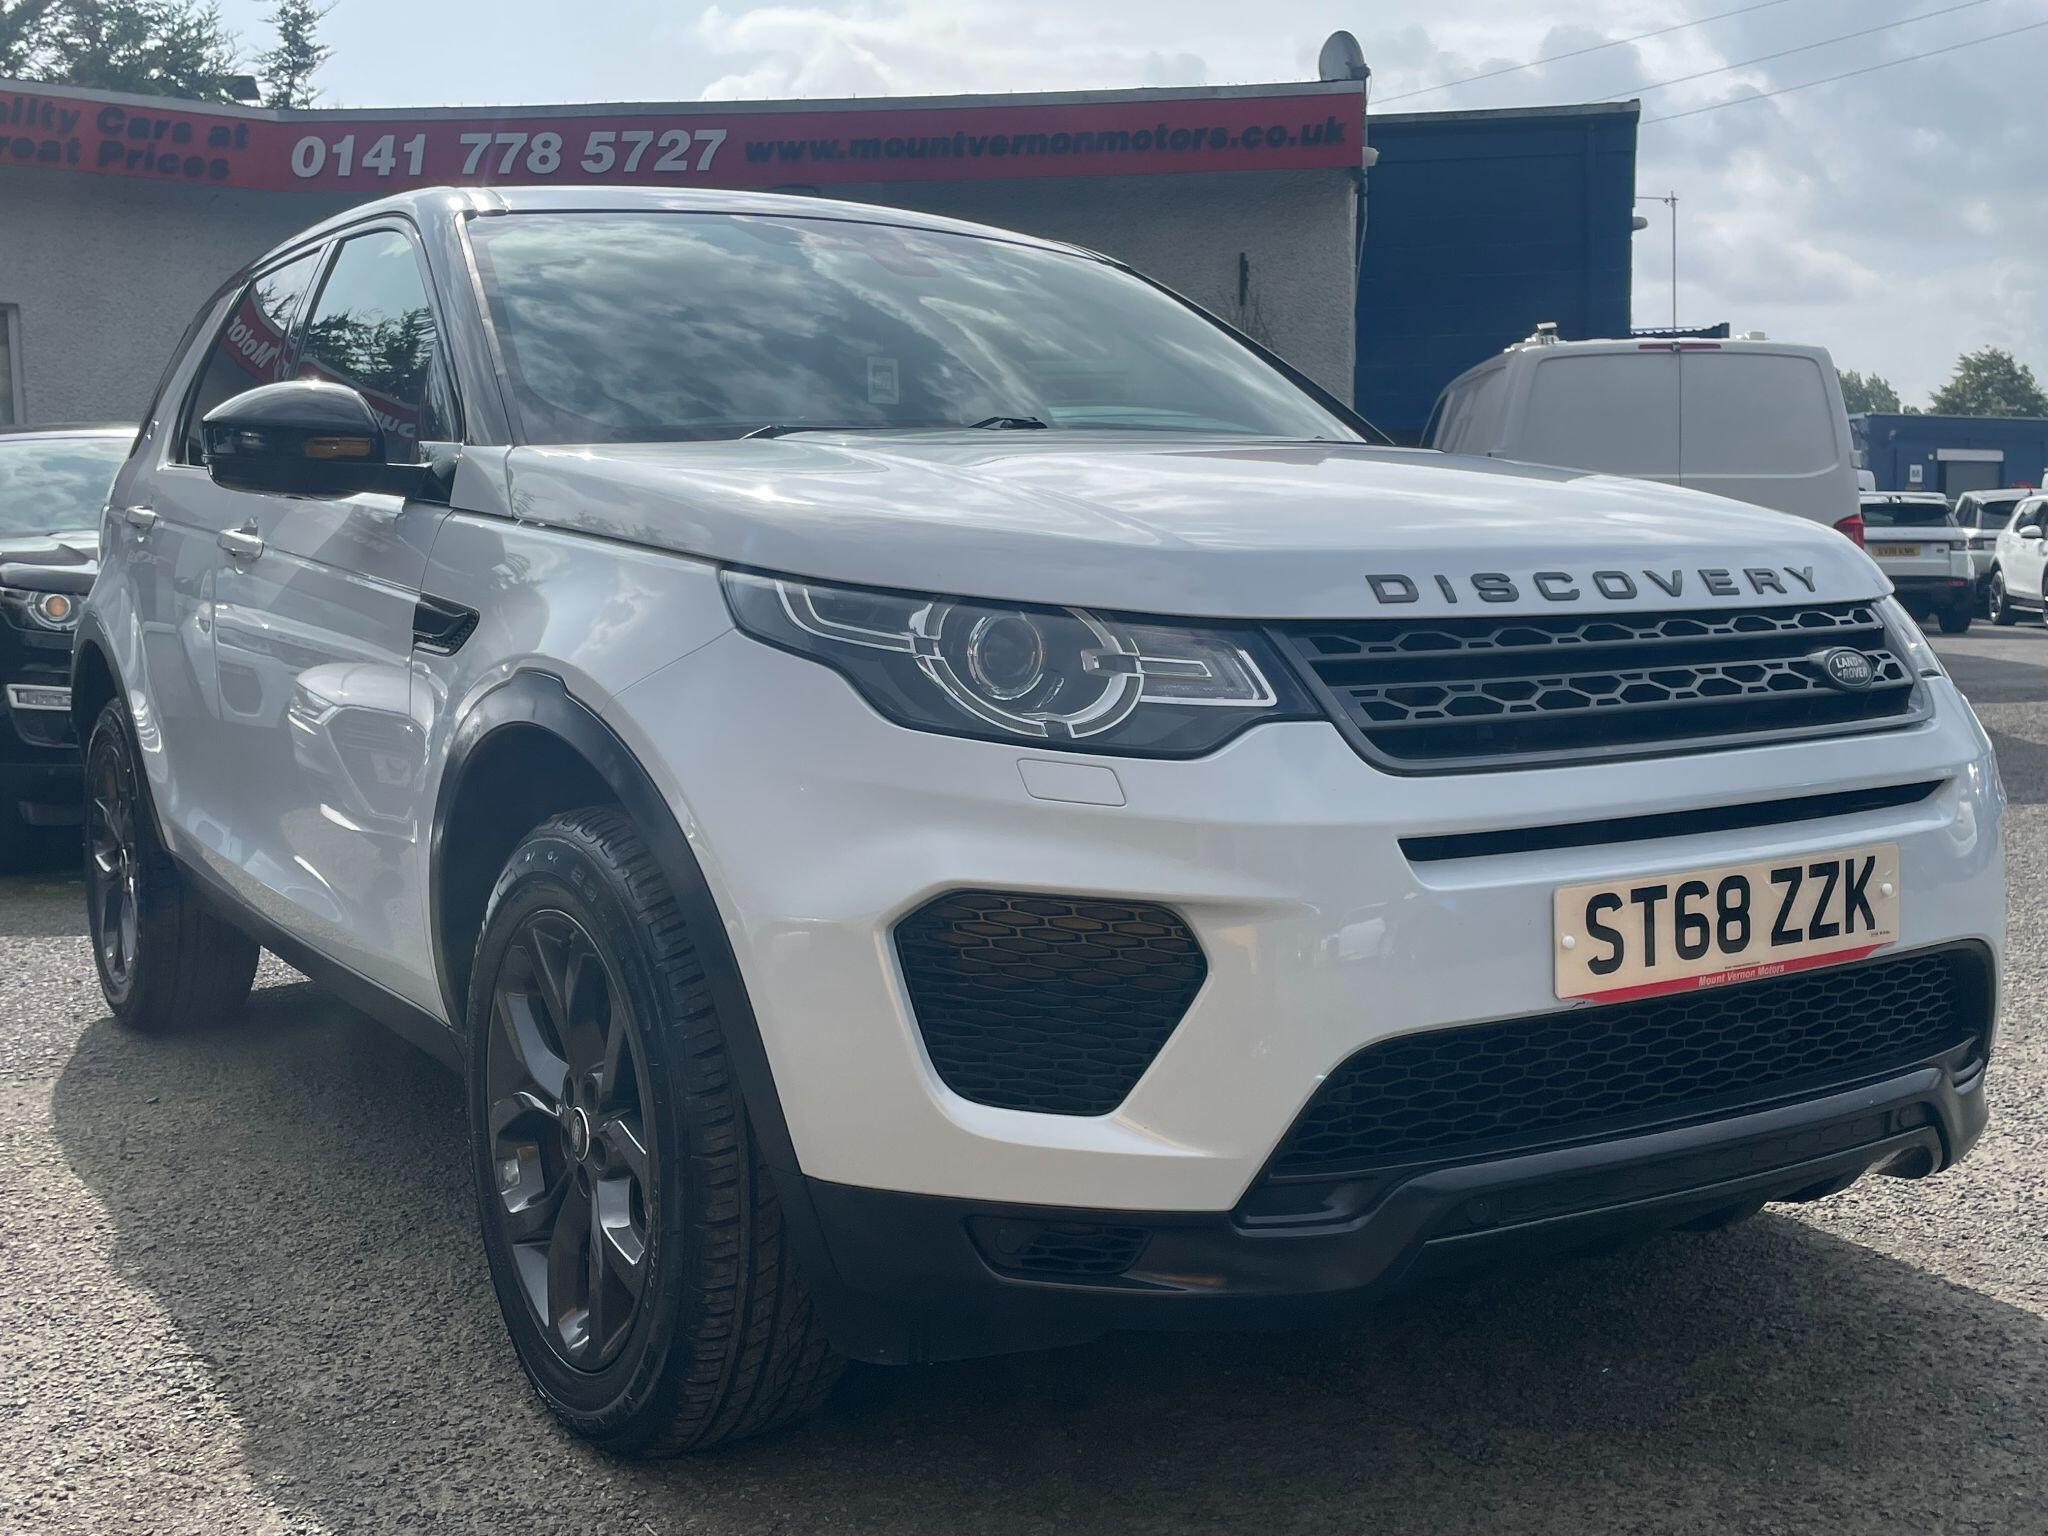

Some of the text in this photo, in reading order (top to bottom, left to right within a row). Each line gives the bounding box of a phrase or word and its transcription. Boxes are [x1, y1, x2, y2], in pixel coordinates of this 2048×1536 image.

[97, 106, 192, 144] Cars
[208, 122, 248, 150] at
[744, 116, 1346, 162] www.mountvernonmotors.co.uk
[97, 140, 230, 180] Prices
[291, 129, 727, 178] 0141 778 5727
[1364, 566, 1816, 604] DISCOVERY
[1835, 656, 1859, 668] LAND
[1842, 666, 1868, 679] ROVER
[1585, 856, 1876, 975] ST68 ZZK
[1698, 973, 1725, 987] Mount
[1727, 969, 1756, 982] Vernon
[1758, 964, 1785, 977] Motors
